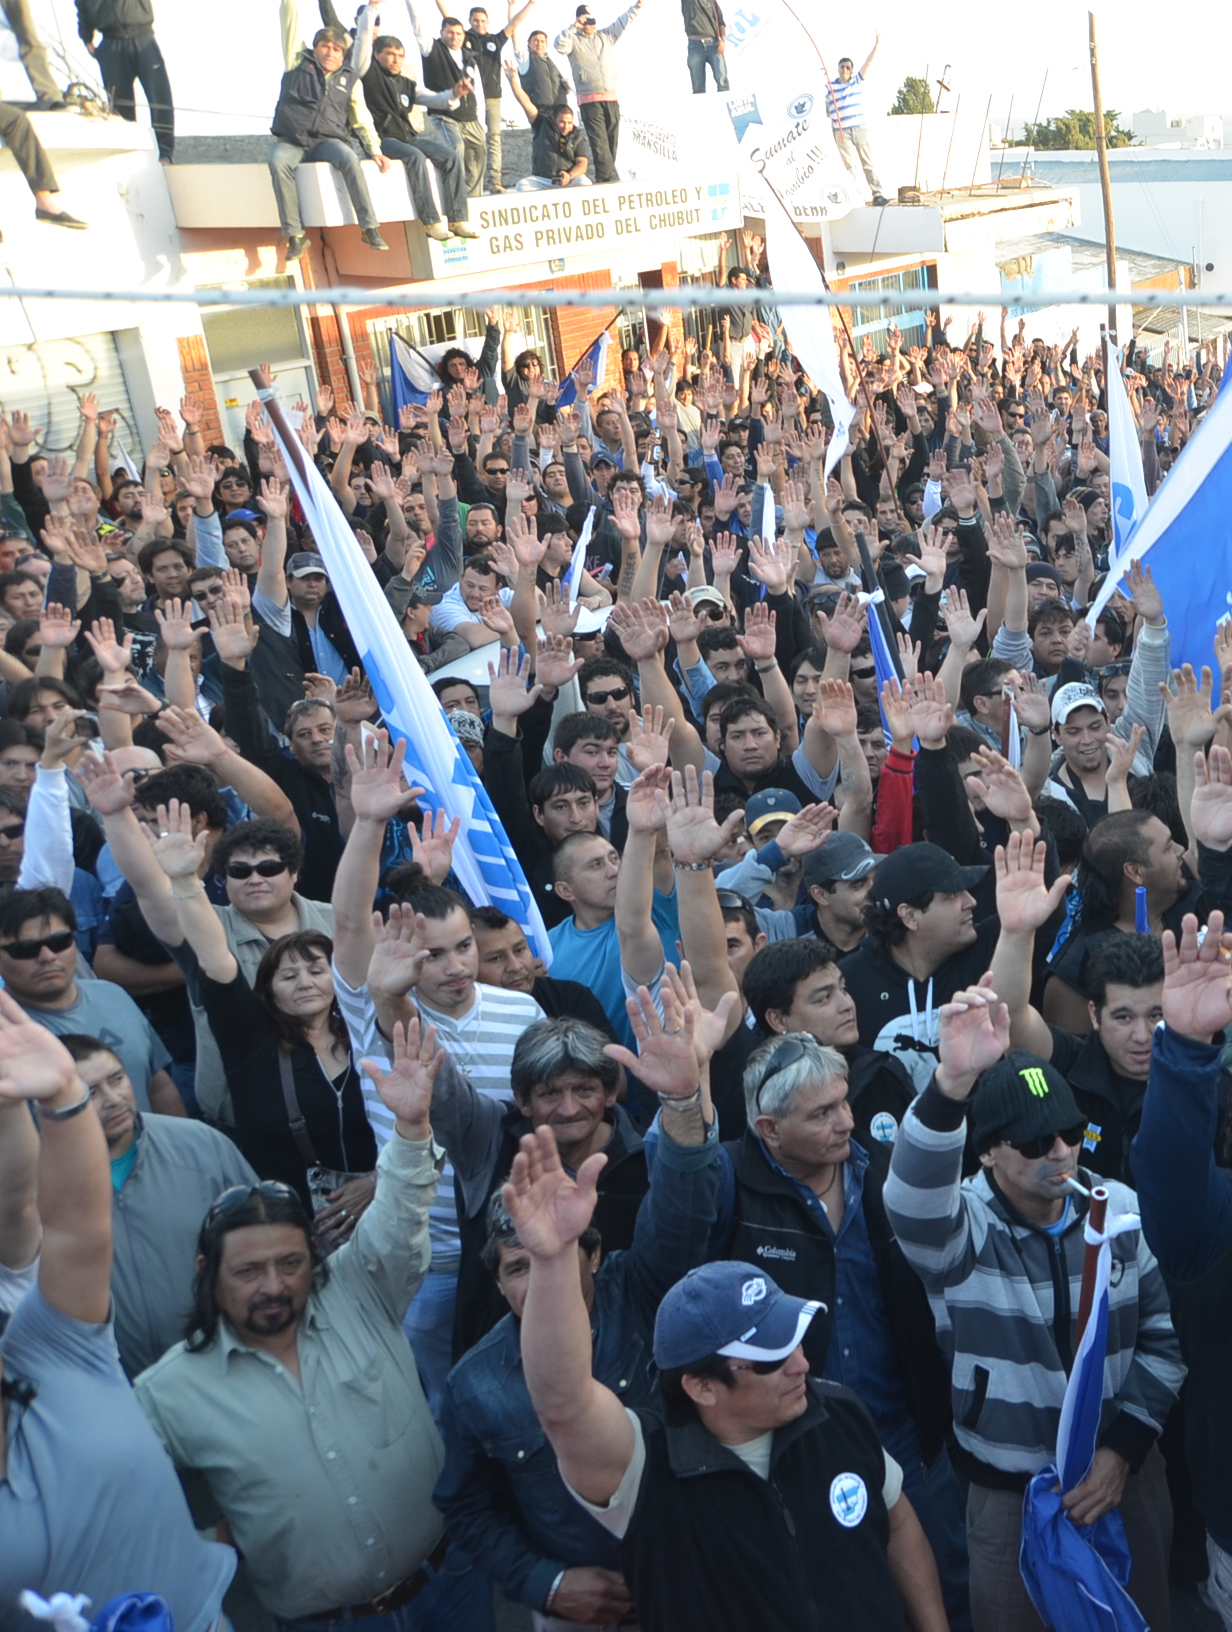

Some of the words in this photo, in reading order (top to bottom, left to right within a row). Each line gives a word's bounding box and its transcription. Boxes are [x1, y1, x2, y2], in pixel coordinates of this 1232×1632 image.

[632, 130, 679, 162] MANSILLA
[479, 201, 572, 229] SINDICATO
[582, 197, 610, 217] DEL
[618, 187, 688, 212] PETROLEO
[695, 186, 703, 201] Y
[489, 232, 524, 255] GAS
[535, 222, 605, 248] PRIVADO
[615, 217, 642, 236] DEL
[649, 207, 701, 230] CHUBUT
[764, 1245, 797, 1258] Columbia
